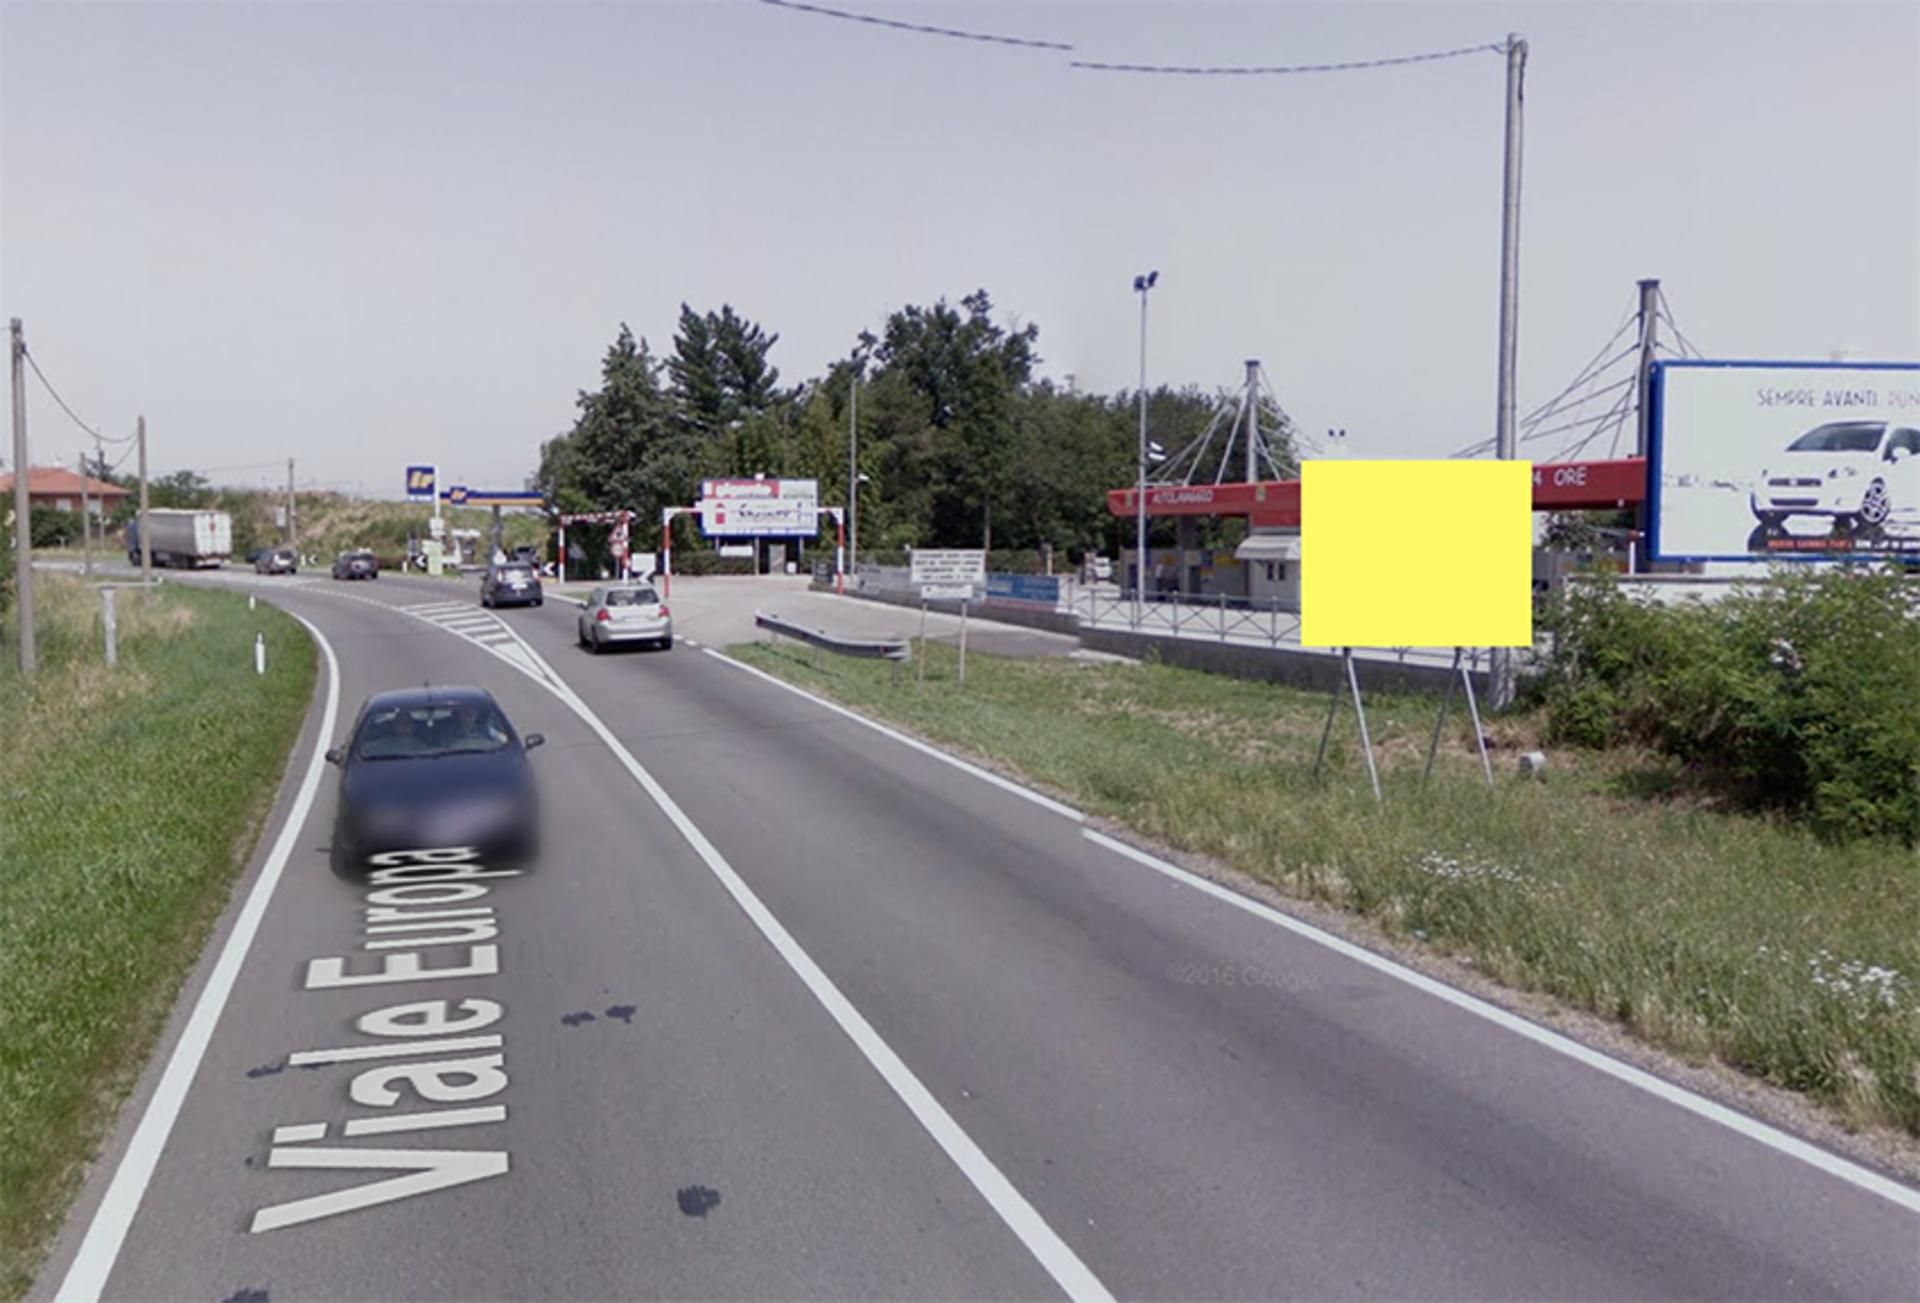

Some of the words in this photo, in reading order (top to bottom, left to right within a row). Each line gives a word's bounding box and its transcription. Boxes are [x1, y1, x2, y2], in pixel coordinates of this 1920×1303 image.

[1757, 388, 1816, 407] SEMPRE
[1823, 389, 1878, 407] AVANTI
[1552, 465, 1588, 487] ORE
